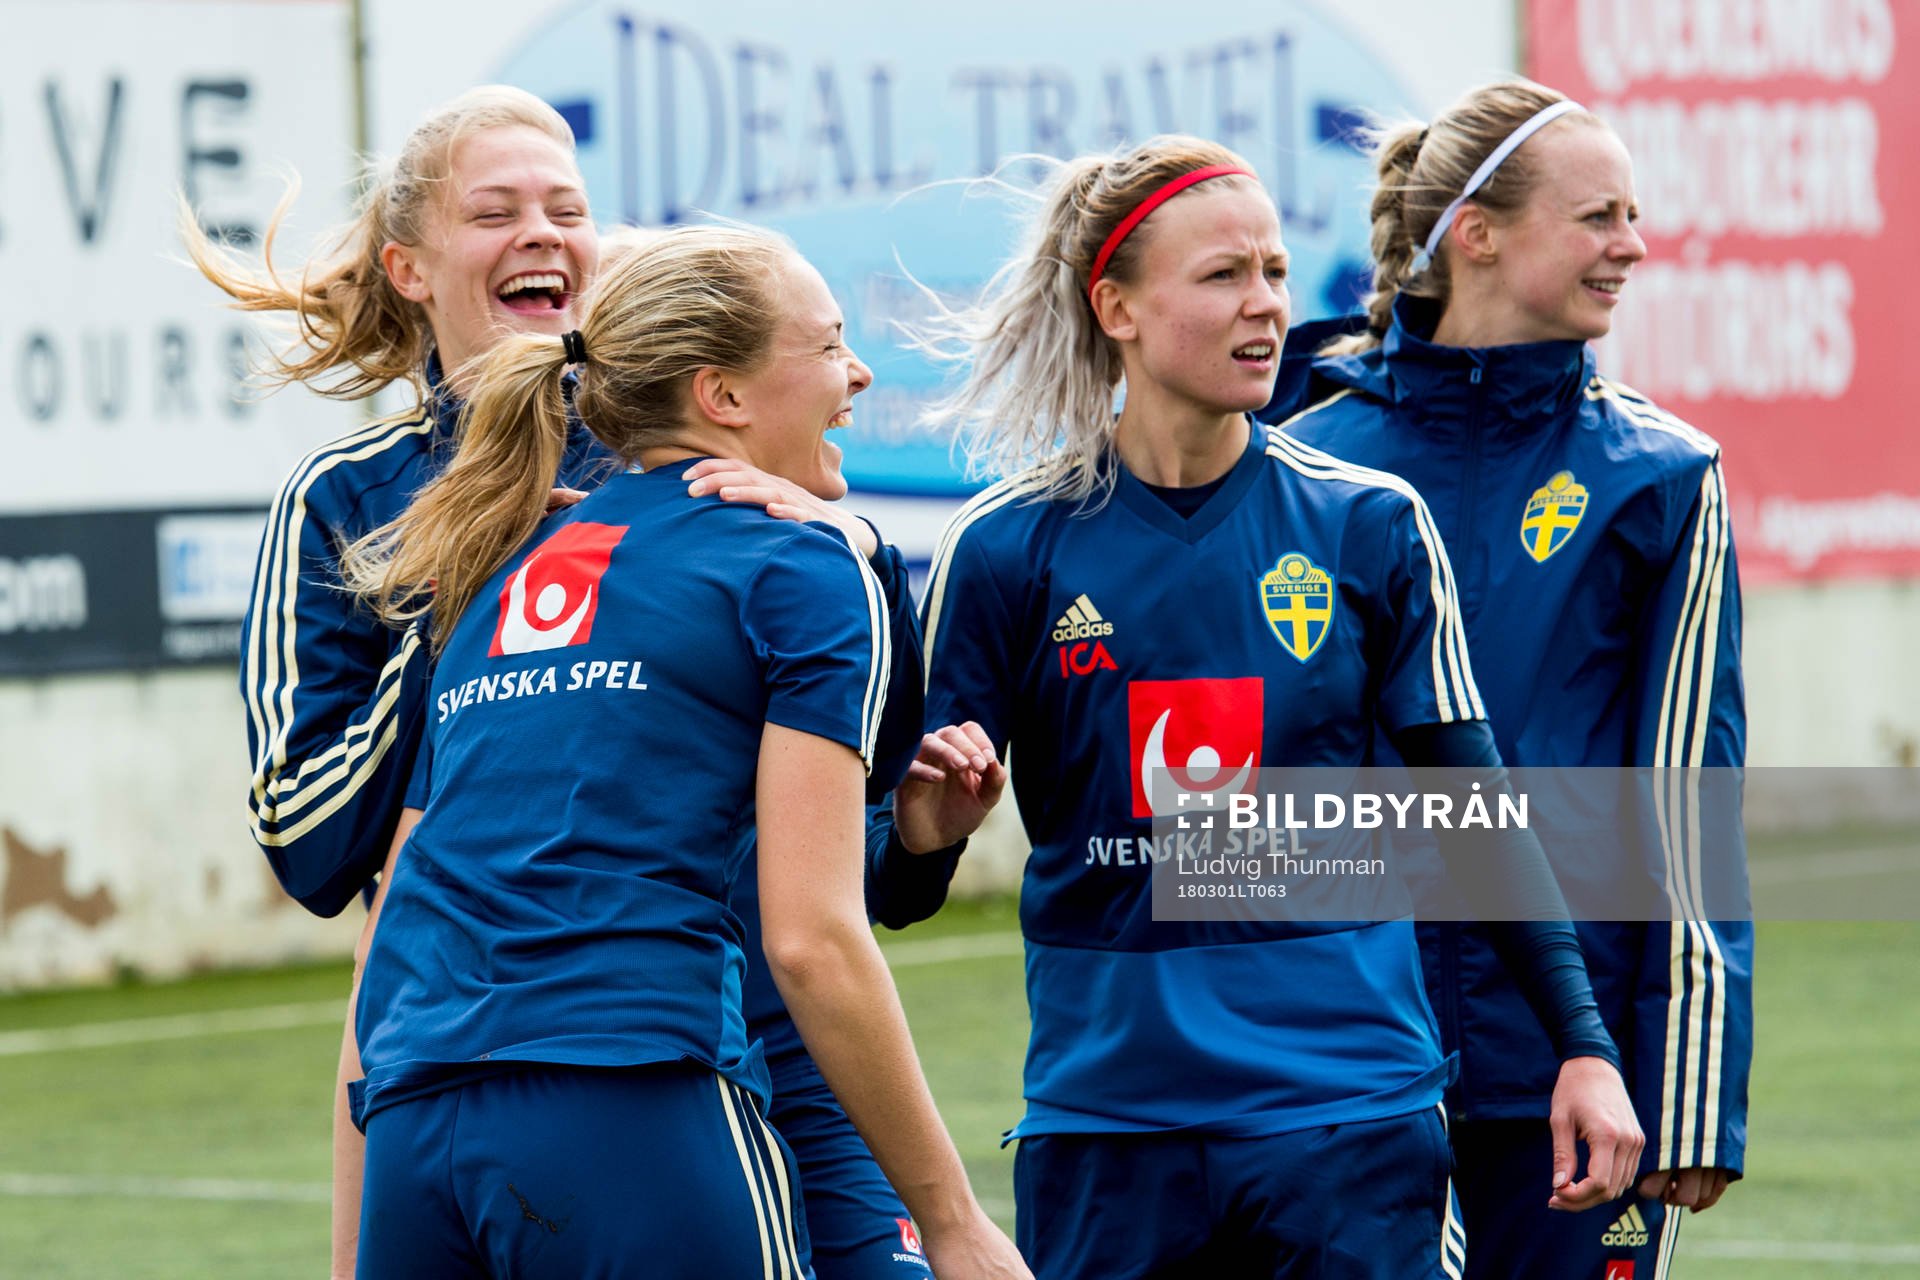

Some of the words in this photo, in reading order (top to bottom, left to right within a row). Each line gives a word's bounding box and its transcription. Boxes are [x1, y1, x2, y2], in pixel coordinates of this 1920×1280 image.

[612, 12, 935, 226] IDEAL
[948, 30, 1336, 236] TRAVEL
[0, 70, 256, 246] VE
[0, 322, 258, 425] OURS
[1272, 584, 1321, 593] SVERIGE
[1052, 621, 1114, 642] adidas
[1059, 639, 1119, 679] ICA
[437, 665, 557, 724] SVENSKA
[566, 660, 648, 691] SPEL
[1085, 829, 1212, 867] SVENSKA
[1223, 826, 1309, 857] SPEL
